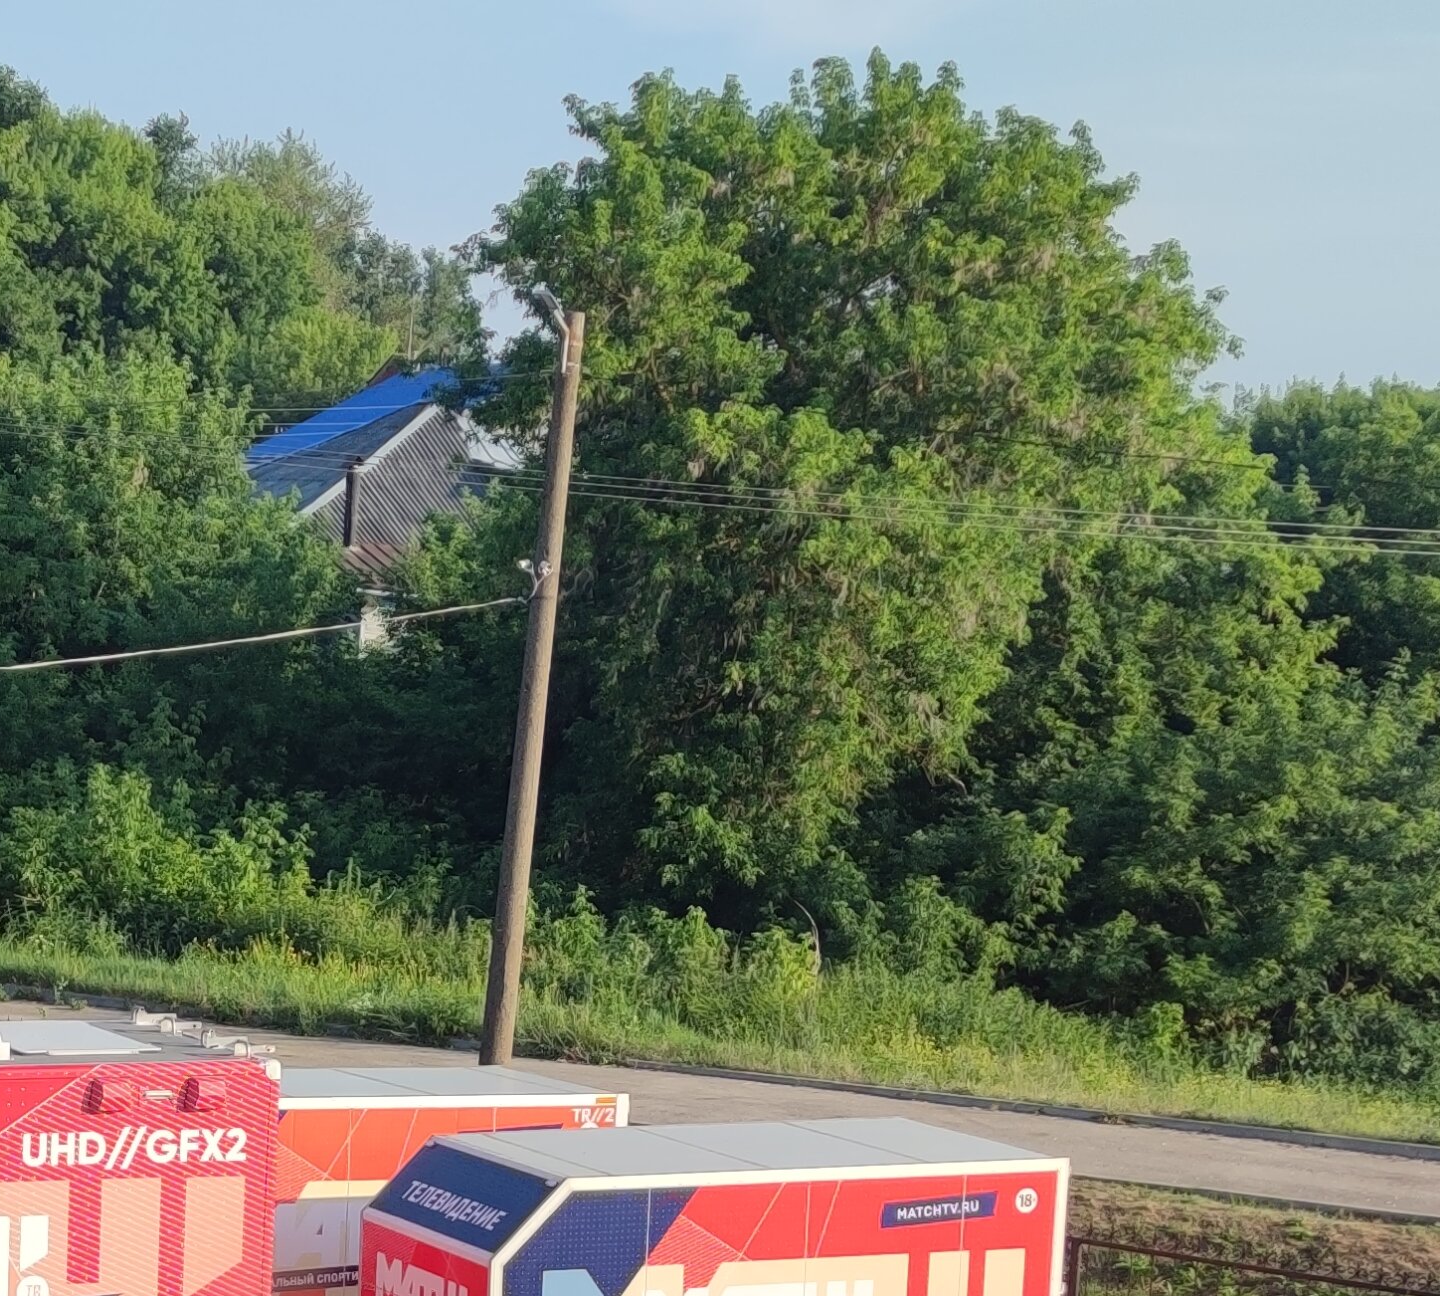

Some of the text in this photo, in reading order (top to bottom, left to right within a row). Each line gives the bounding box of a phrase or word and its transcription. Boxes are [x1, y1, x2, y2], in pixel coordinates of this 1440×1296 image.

[571, 1107, 615, 1123] TR//2
[22, 1125, 248, 1170] UHD//GFX2
[401, 1180, 509, 1231] ТЕЛЕВИДЕНИЕ
[896, 1200, 980, 1220] MATCHTV.RU
[316, 1271, 359, 1283] СПОРТИ
